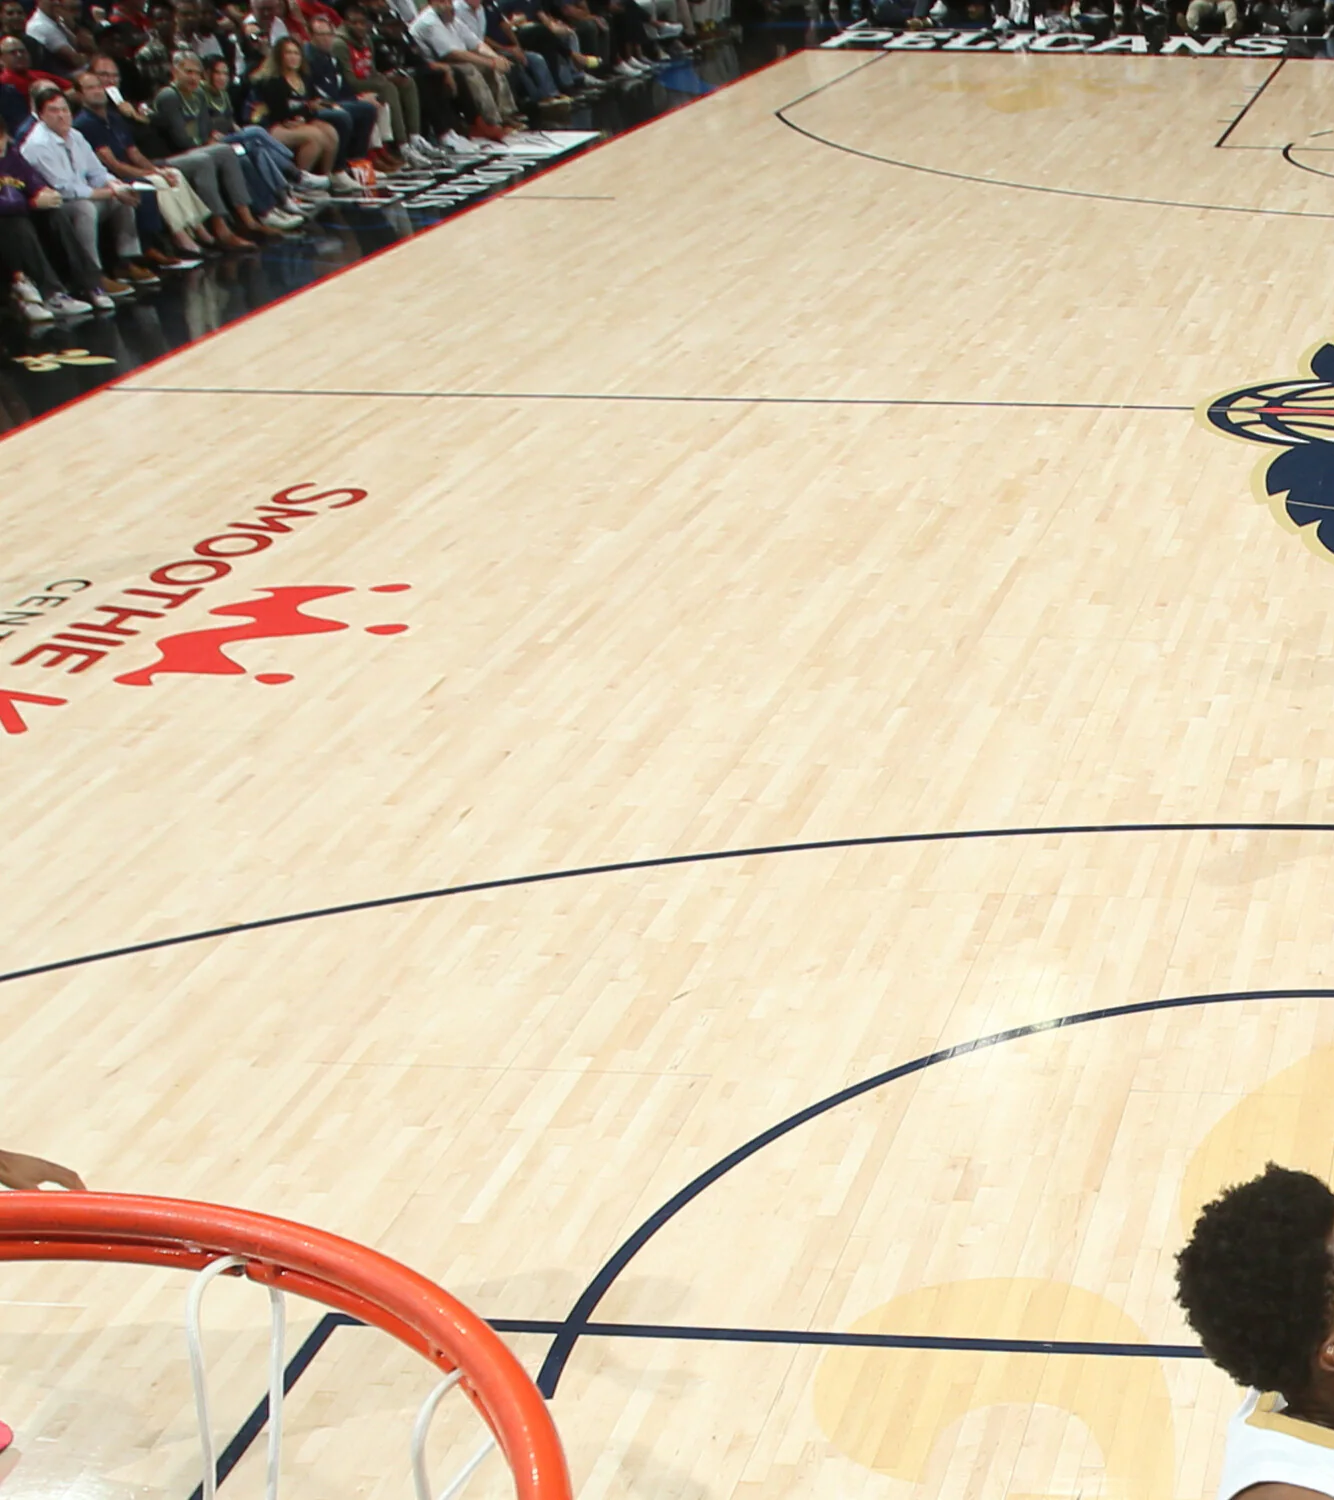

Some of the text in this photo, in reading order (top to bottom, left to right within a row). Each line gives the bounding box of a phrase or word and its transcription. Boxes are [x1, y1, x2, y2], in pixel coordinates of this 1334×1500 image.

[820, 29, 1288, 55] PELICANS
[0, 578, 93, 642] CEN
[10, 483, 368, 674] SMOOTHIE
